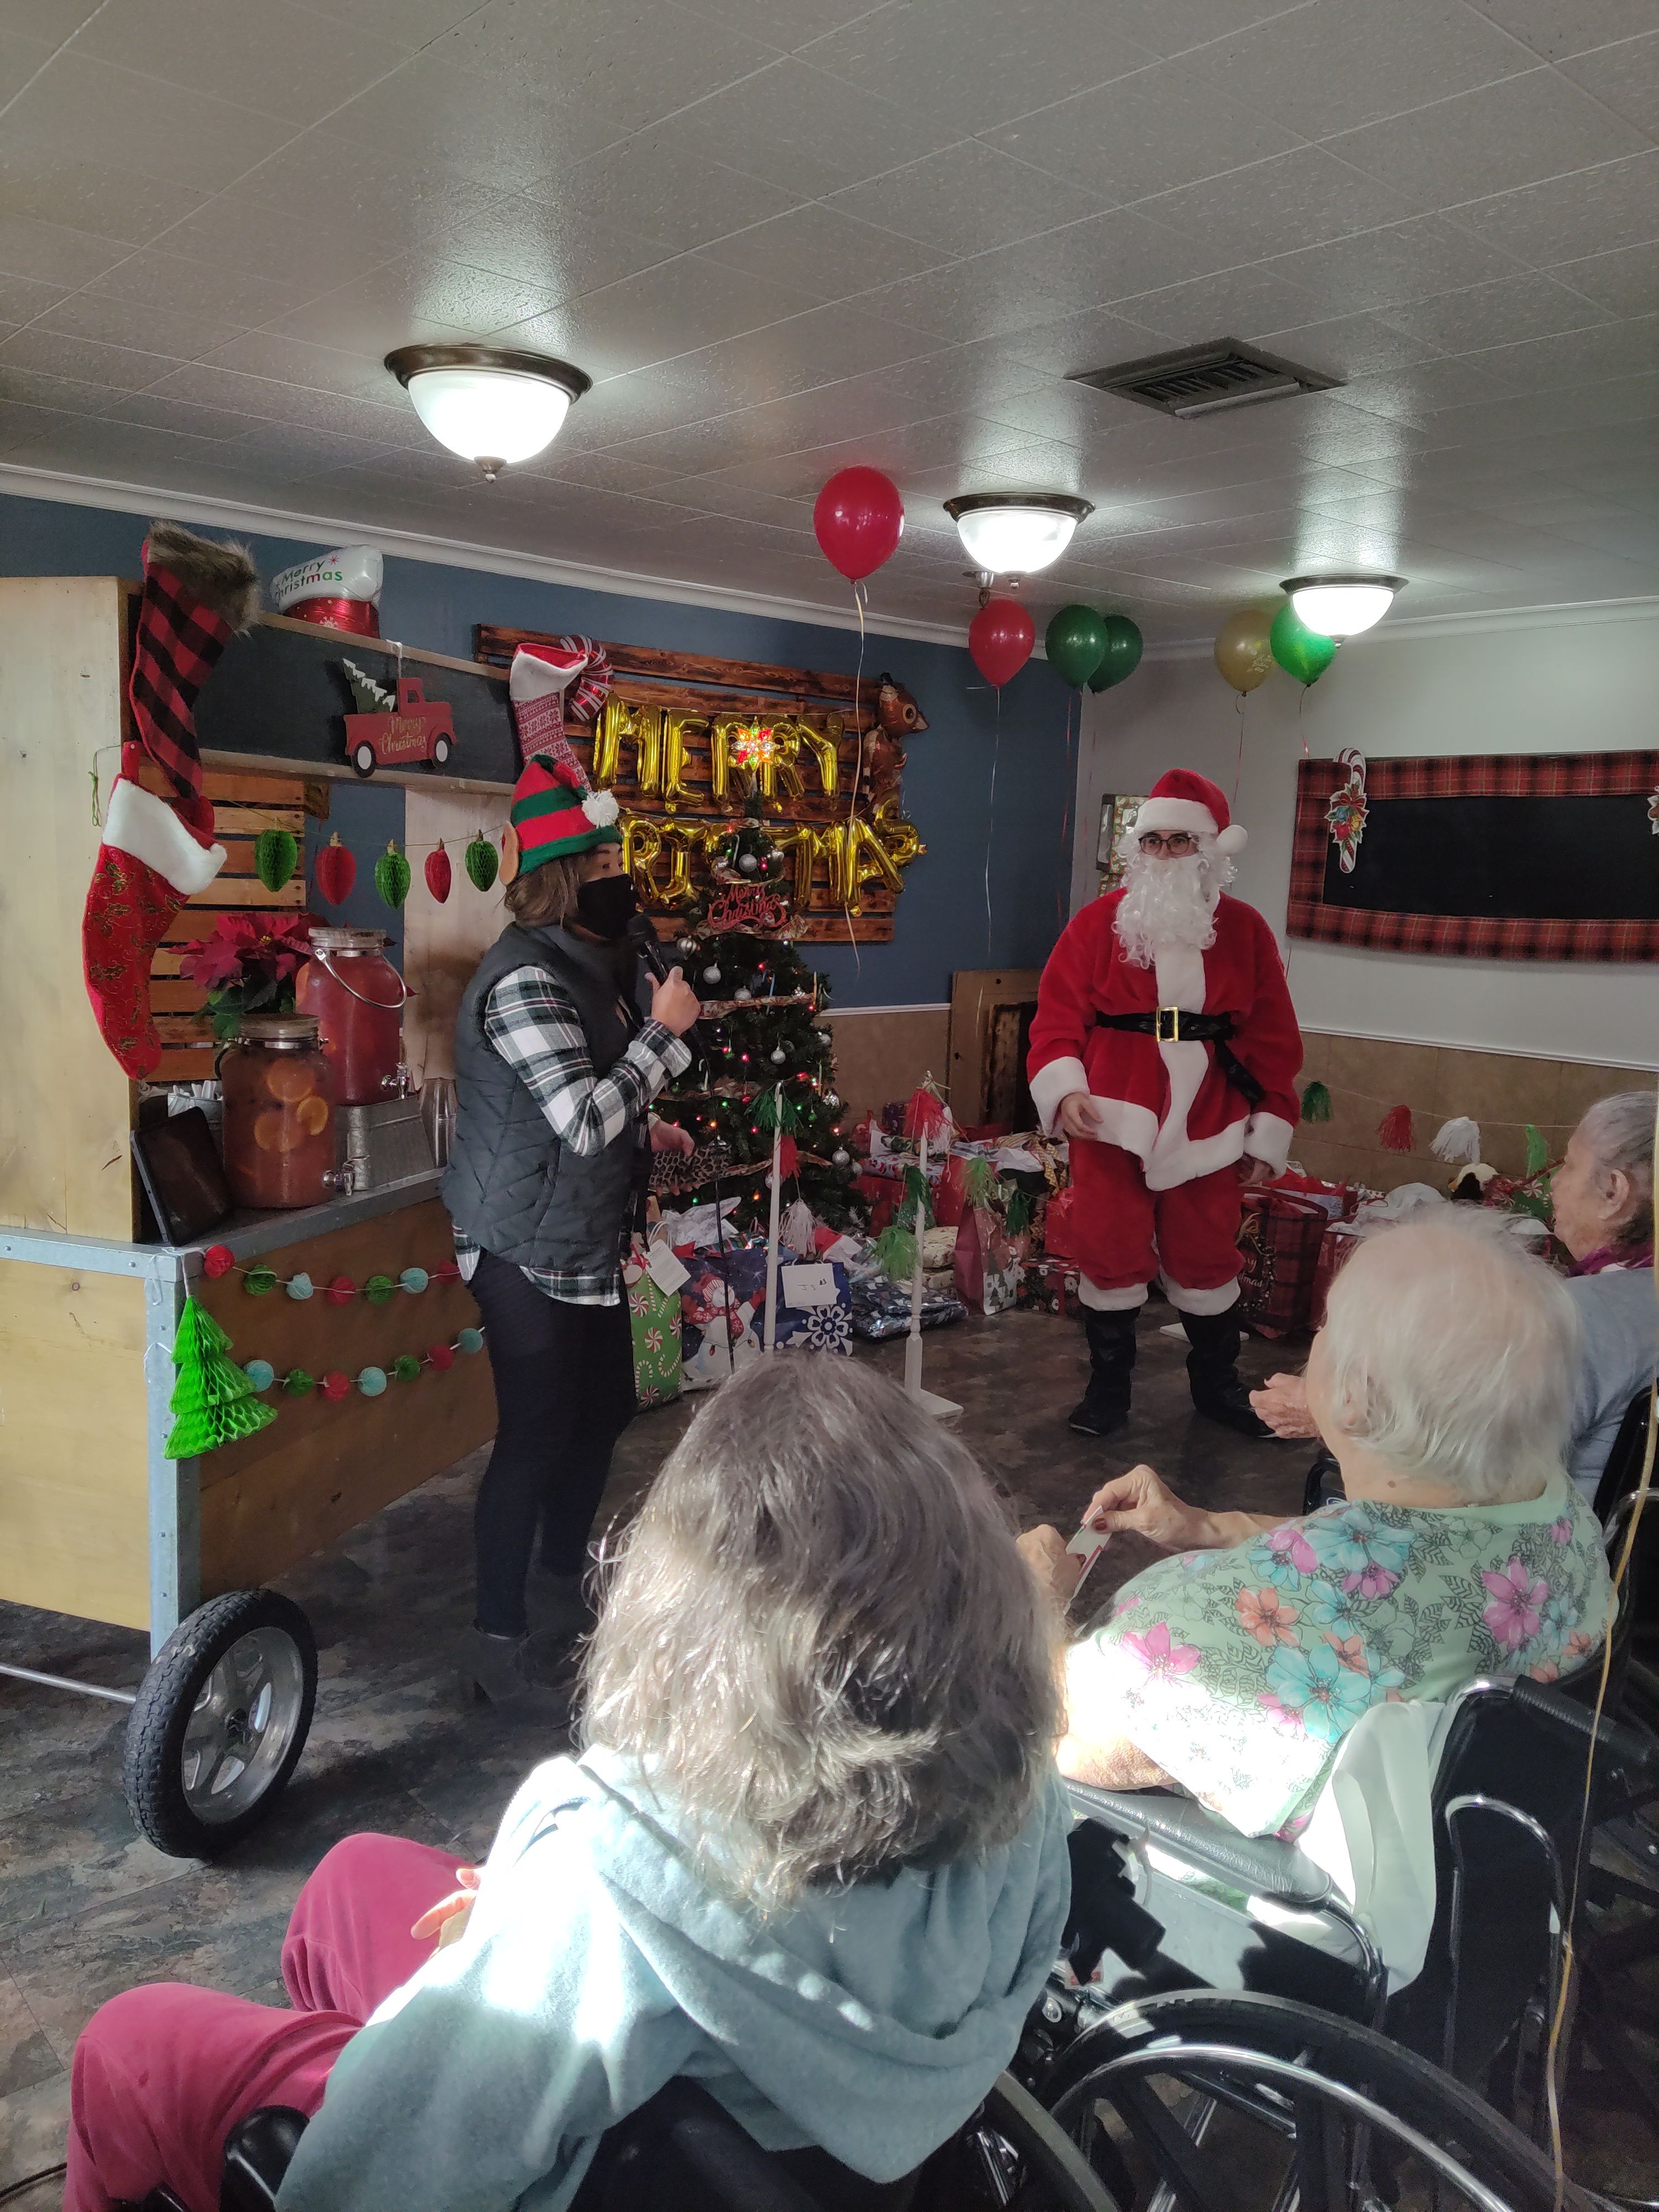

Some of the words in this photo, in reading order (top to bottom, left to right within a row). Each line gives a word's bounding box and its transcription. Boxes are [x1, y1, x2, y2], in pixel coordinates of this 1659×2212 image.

[281, 560, 325, 585] Merry
[388, 716, 426, 734] Merry
[379, 731, 427, 755] Christmas
[593, 692, 844, 809] MERRY
[726, 884, 766, 904] Merry
[708, 893, 787, 930] Christmas
